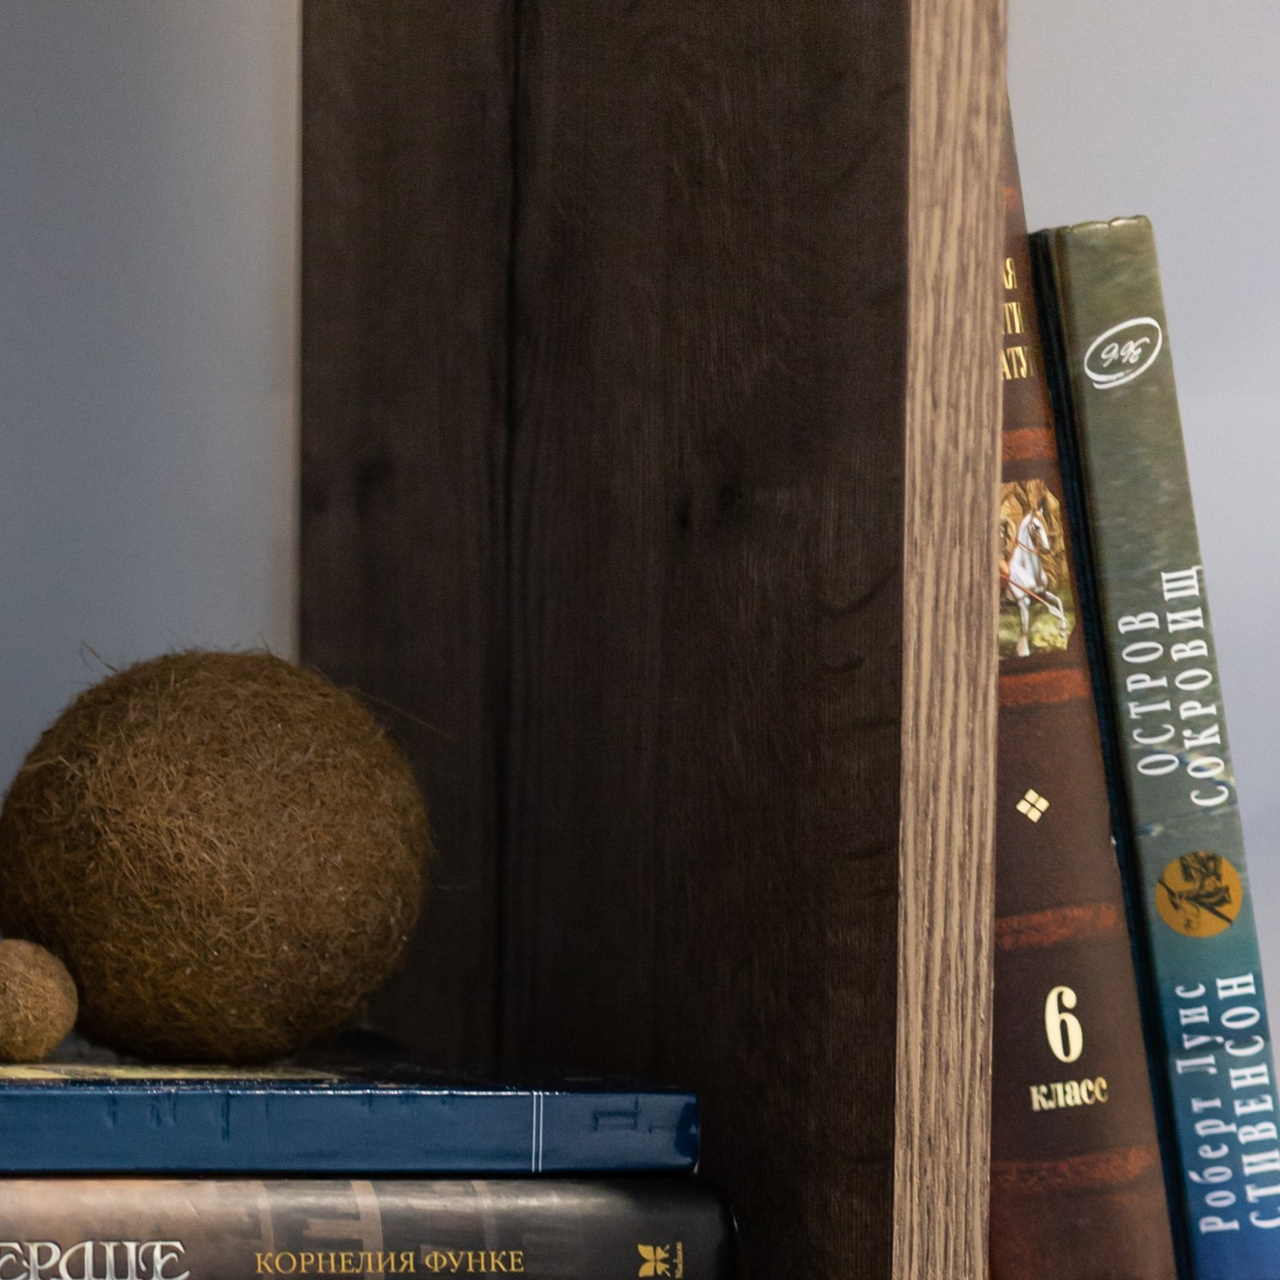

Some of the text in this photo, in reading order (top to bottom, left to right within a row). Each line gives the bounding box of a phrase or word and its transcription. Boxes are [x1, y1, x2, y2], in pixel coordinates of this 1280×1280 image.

[1118, 611, 1180, 776] ОСТРОВ
[1161, 565, 1229, 807] СОКРОВИЩ
[1029, 1076, 1108, 1112] класс
[1044, 985, 1083, 1064] 6
[1216, 973, 1280, 1230] СТИВЕНСОН
[1175, 983, 1240, 1234] Роберт Луис
[255, 1250, 524, 1274] КОРНЕЛИЯ ФУНКЕ
